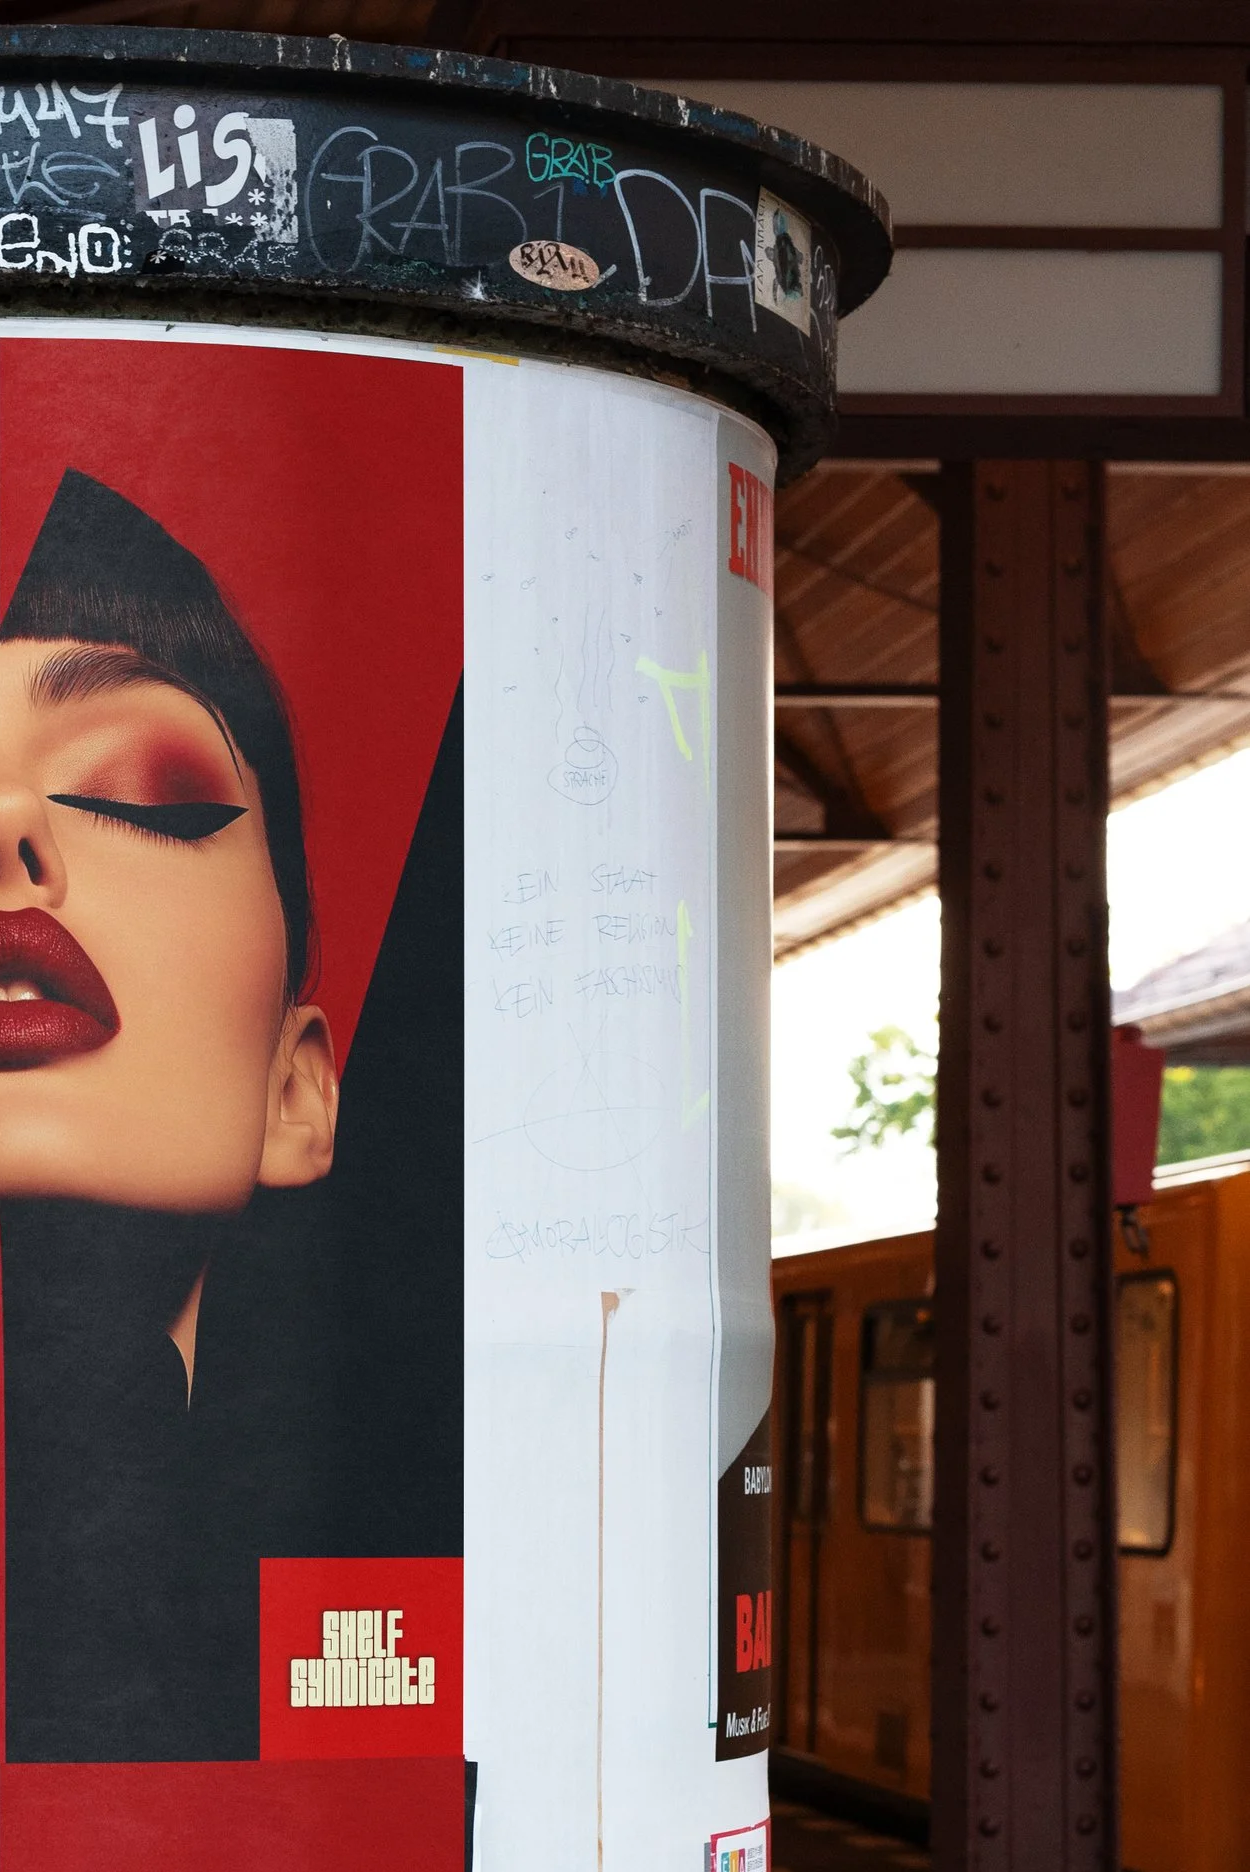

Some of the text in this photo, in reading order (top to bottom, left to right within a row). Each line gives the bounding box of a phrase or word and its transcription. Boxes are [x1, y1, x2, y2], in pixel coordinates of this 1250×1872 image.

[526, 132, 617, 189] GRAB
[303, 126, 528, 273] GRAB
[751, 1707, 756, 1724] &
